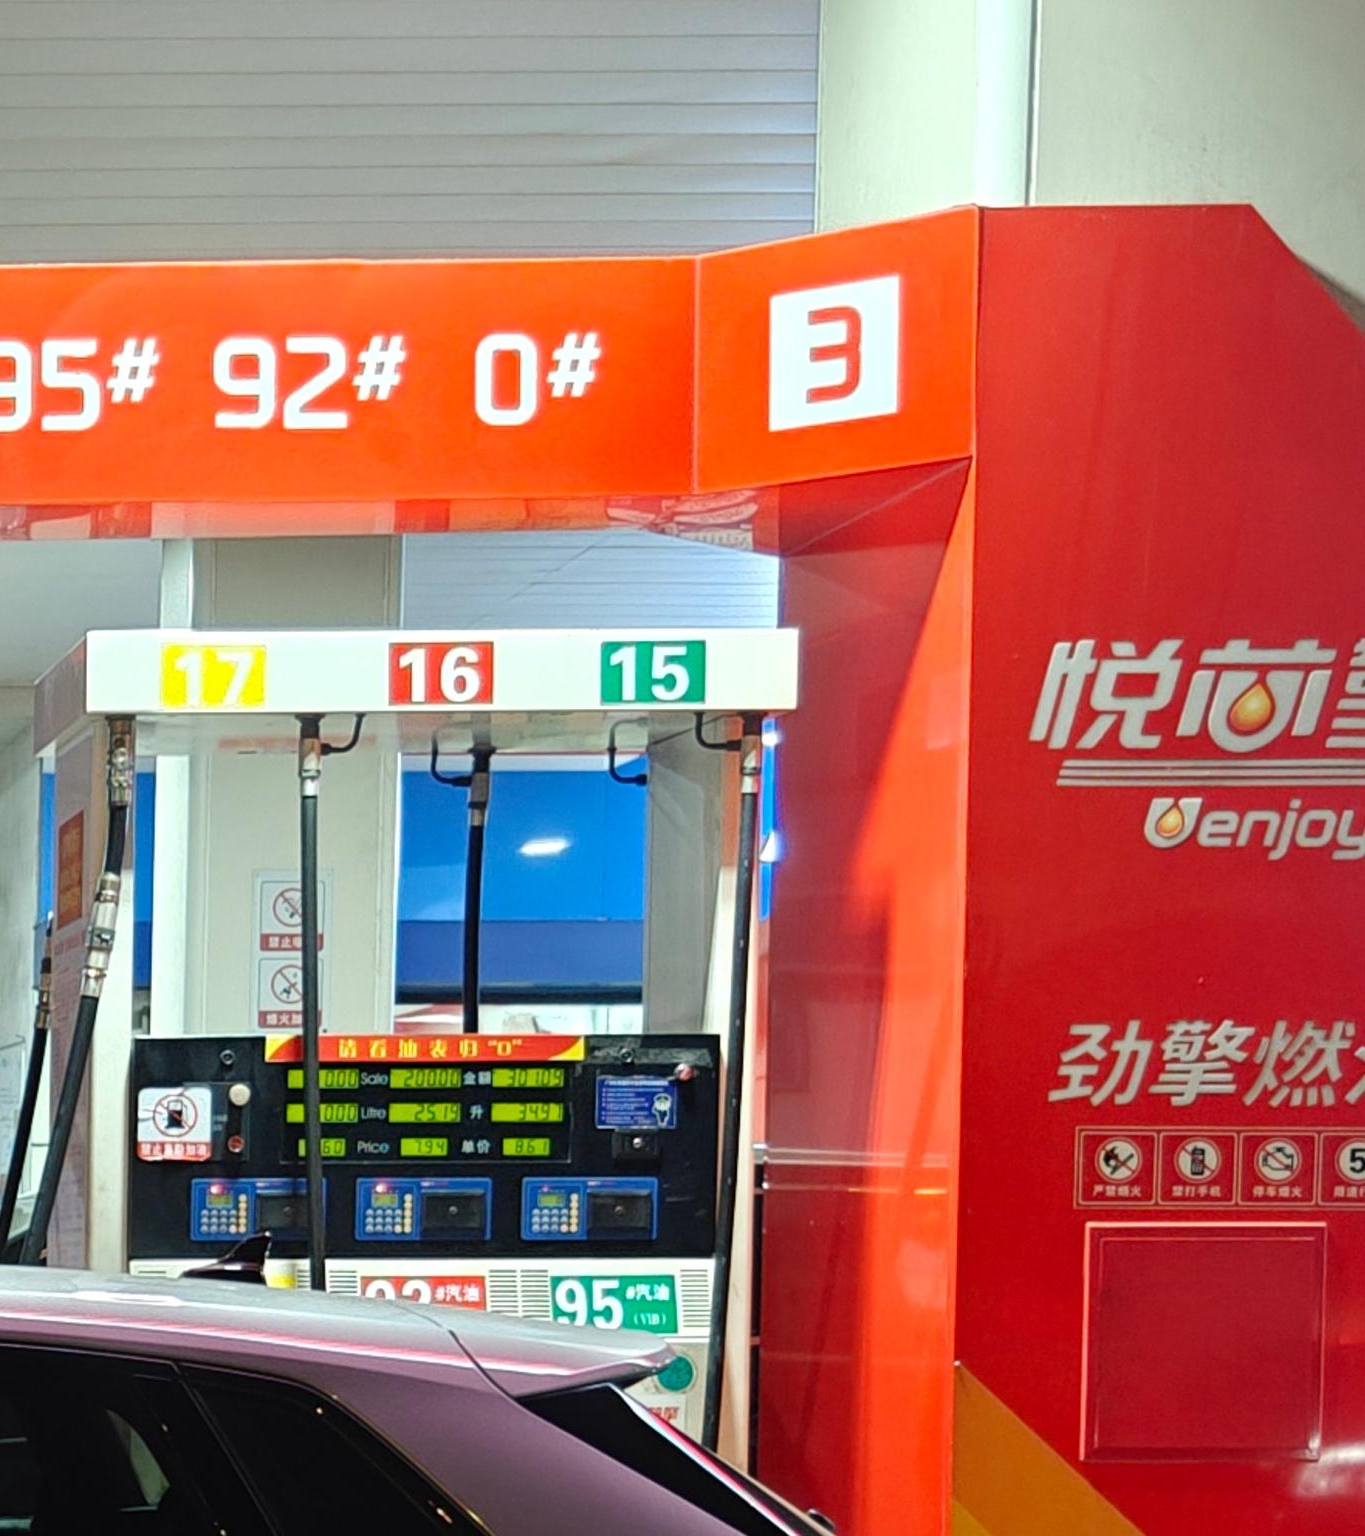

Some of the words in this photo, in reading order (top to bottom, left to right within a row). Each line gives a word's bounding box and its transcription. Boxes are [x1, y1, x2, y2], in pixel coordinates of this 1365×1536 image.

[212, 333, 407, 431] 92#
[474, 331, 602, 426] 0#
[805, 306, 863, 405] 3
[174, 652, 254, 707] 17
[398, 648, 483, 703] 16
[608, 648, 691, 701] 15
[1029, 639, 1365, 753] 悦芯
[266, 1013, 302, 1025] 熄火加
[361, 1071, 388, 1086] Sale
[1048, 1019, 1365, 1107] 劲擎燃
[361, 1106, 387, 1120] Litre
[470, 1106, 484, 1120] 升
[357, 1140, 390, 1154] Price
[461, 1140, 491, 1154] 单价
[554, 1279, 624, 1330] 95
